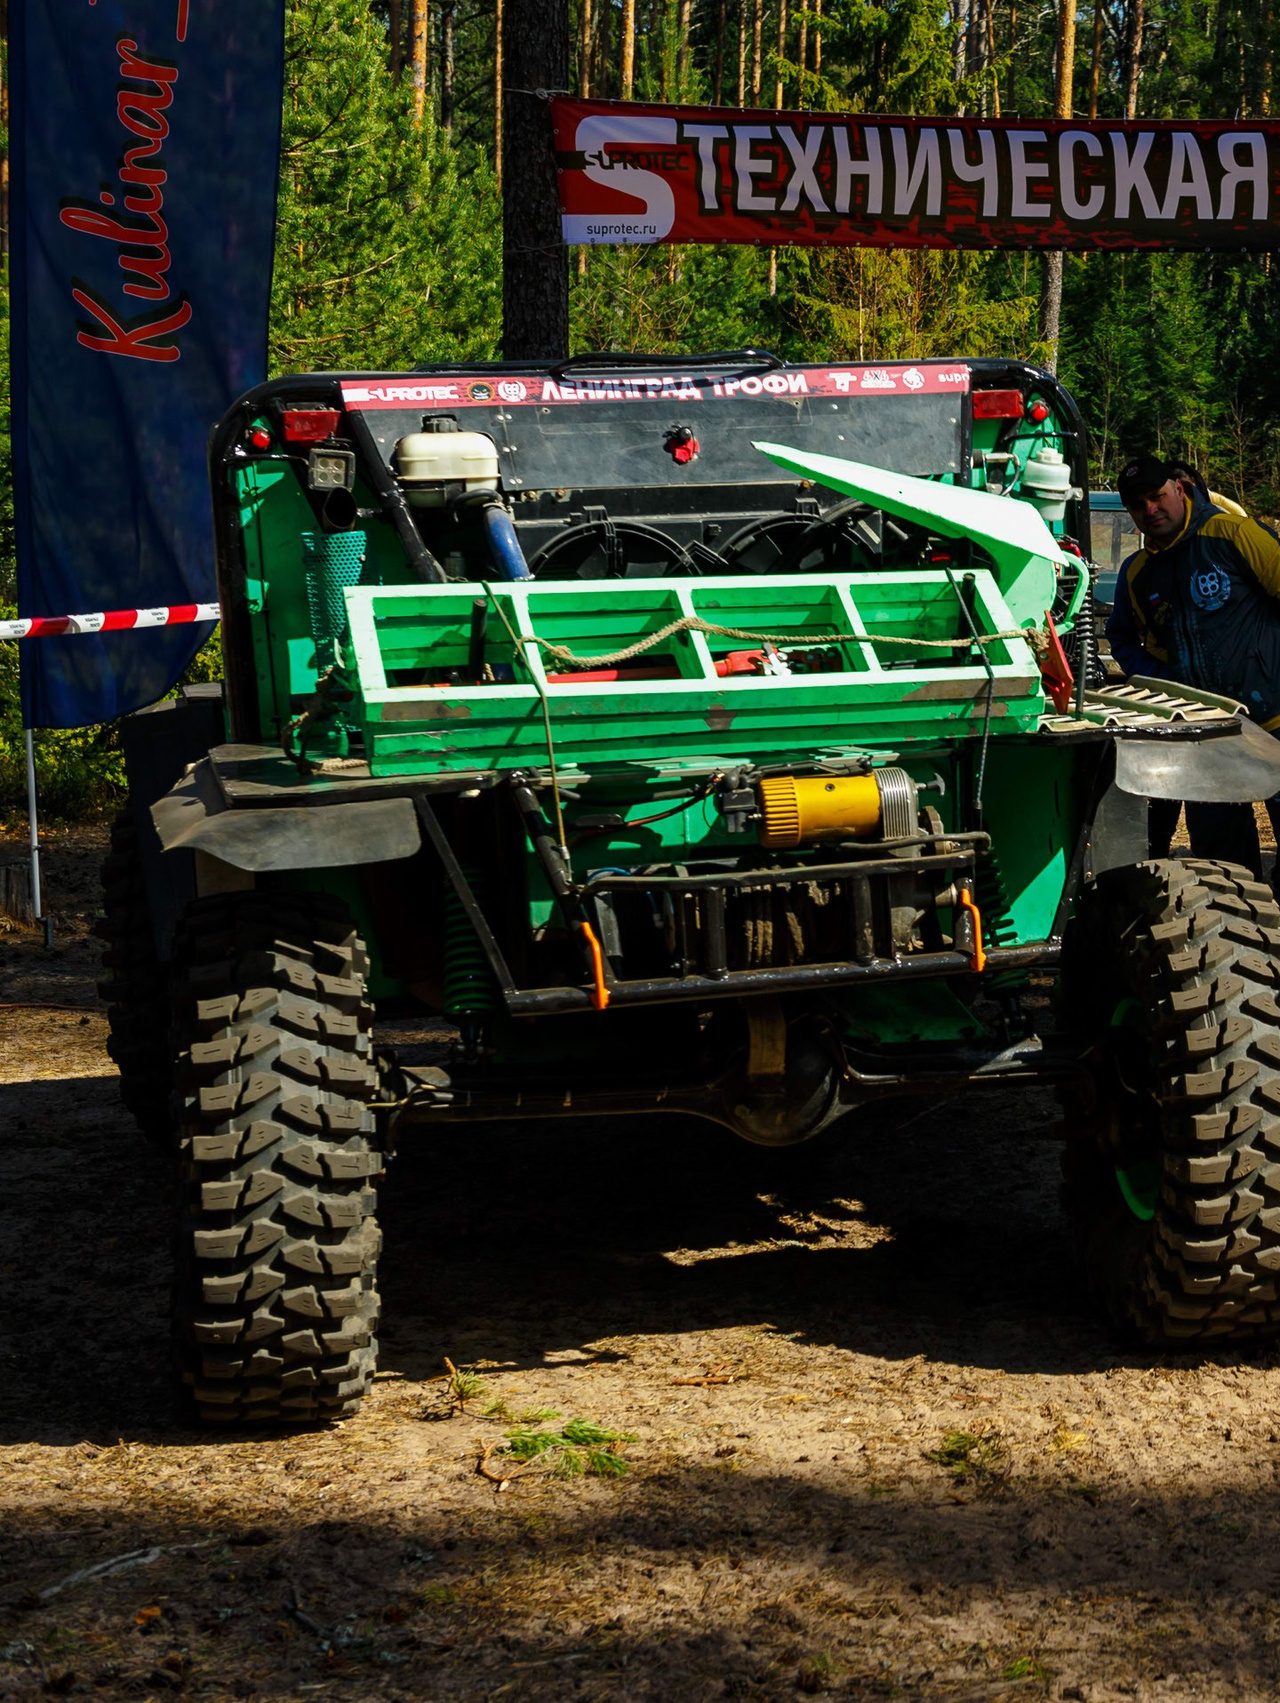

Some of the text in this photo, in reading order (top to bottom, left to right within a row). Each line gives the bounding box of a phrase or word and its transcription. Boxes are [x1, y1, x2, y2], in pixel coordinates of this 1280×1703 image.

[584, 150, 690, 171] SUPROTEC
[683, 123, 1269, 221] ТЕХНИЧЕСКАЯ
[586, 223, 657, 238] suprotec.ru
[367, 385, 459, 402] SUPROTEC
[541, 376, 702, 401] ЛЕНИНГРАД
[712, 374, 809, 397] ТРОФИ
